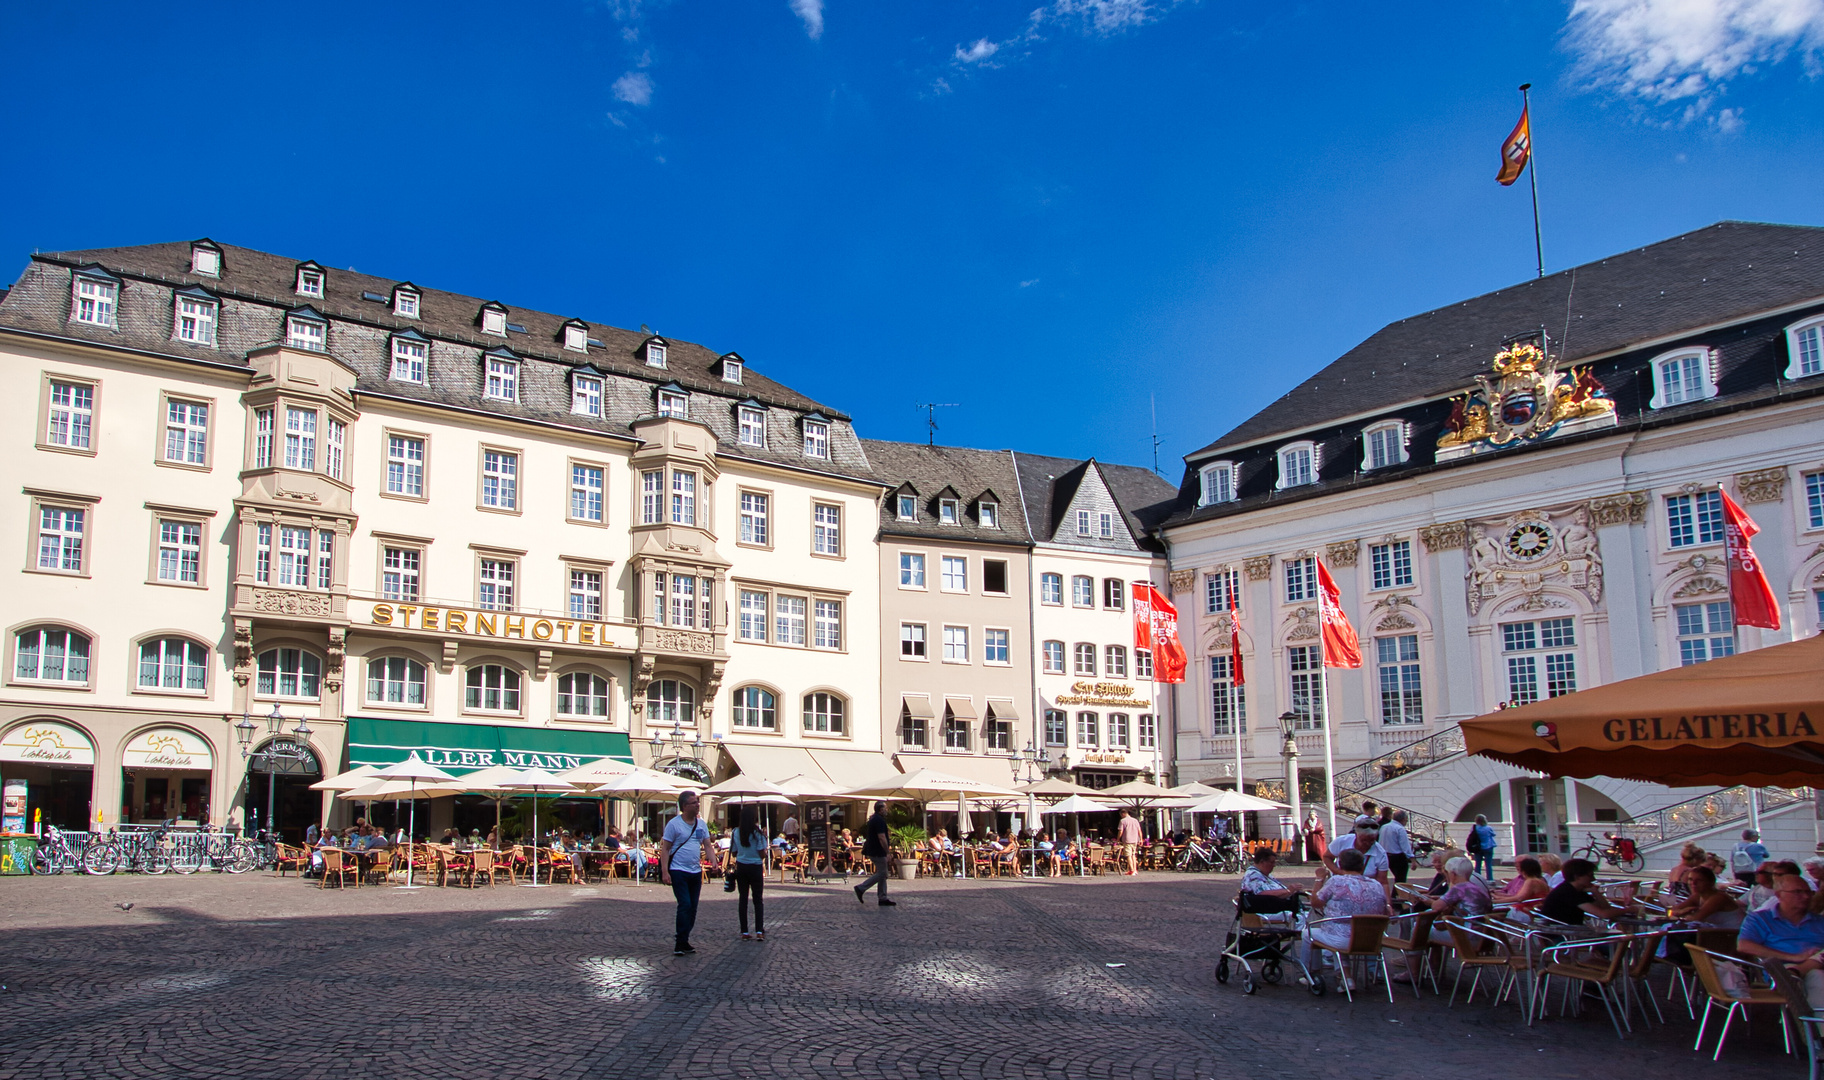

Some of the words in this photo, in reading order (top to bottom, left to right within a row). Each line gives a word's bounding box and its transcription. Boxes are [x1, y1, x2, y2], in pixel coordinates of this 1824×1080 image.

[372, 603, 614, 646] STERNHOTEL
[1150, 610, 1175, 622] BEET
[1150, 627, 1175, 639] FEST
[1602, 711, 1818, 743] GELATERIA
[24, 727, 64, 746] Stern
[147, 734, 184, 752] Stern
[503, 752, 581, 769] MANN
